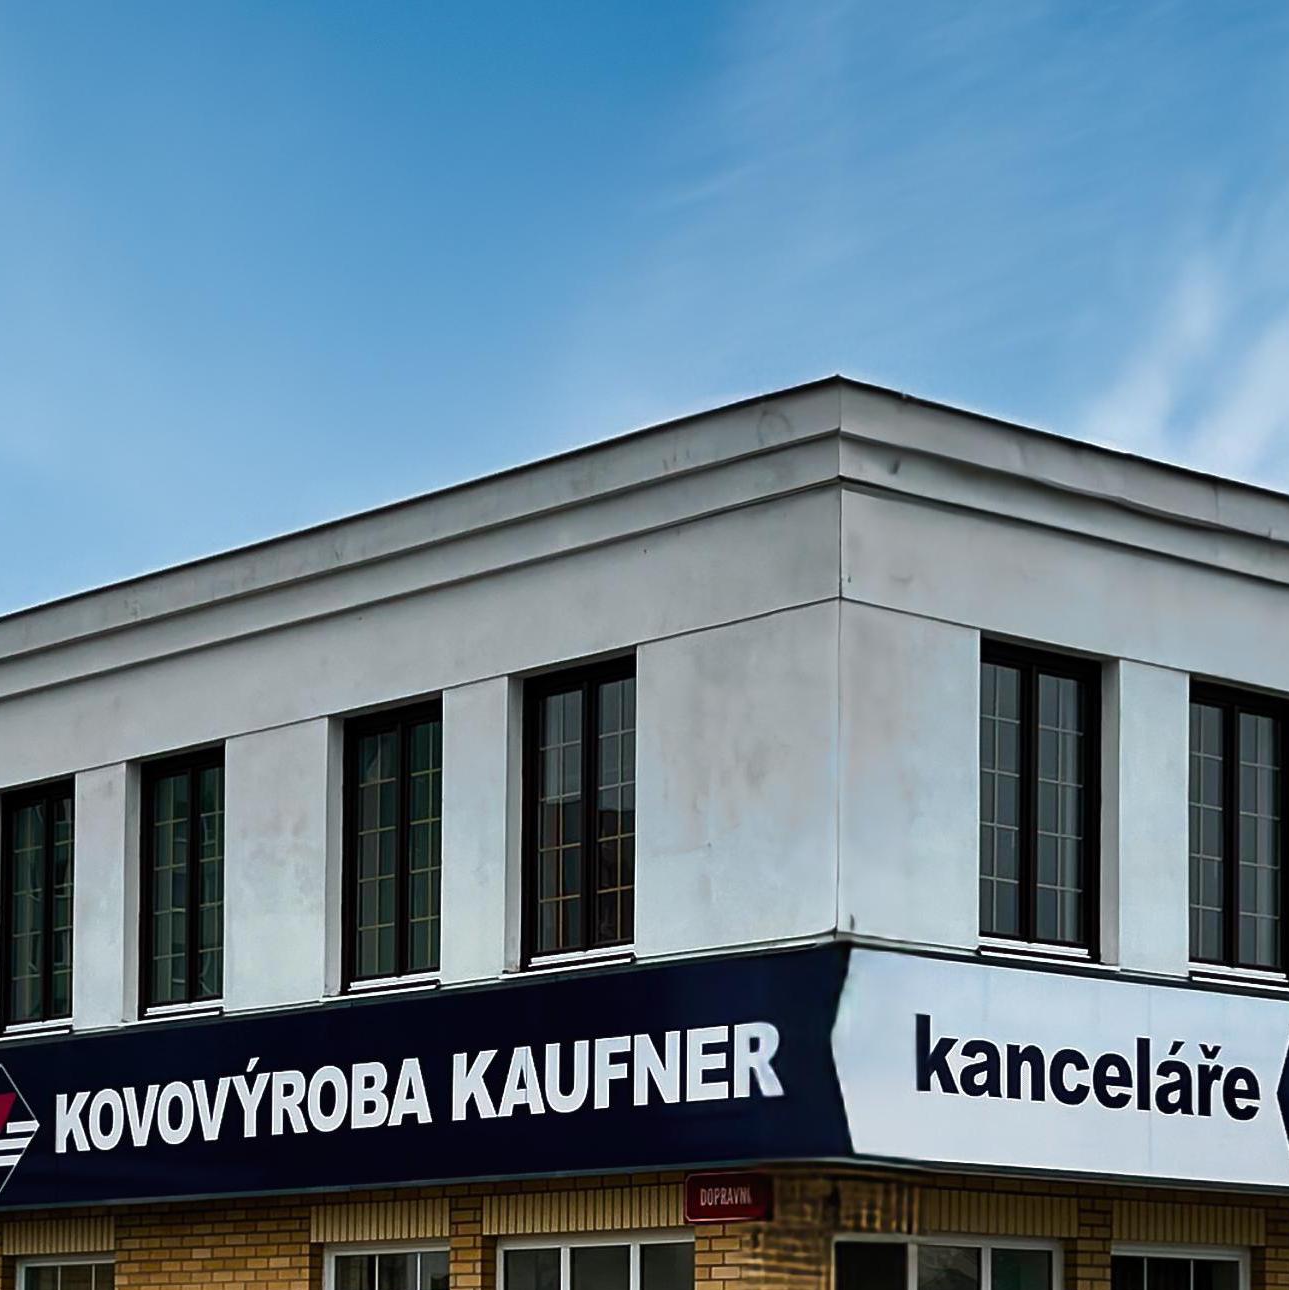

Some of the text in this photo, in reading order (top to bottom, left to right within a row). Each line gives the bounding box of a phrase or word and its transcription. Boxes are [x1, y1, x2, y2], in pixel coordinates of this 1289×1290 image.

[55, 1021, 785, 1154] KOVOVÝROBA KAUFNER
[915, 1013, 1261, 1121] kanceláře
